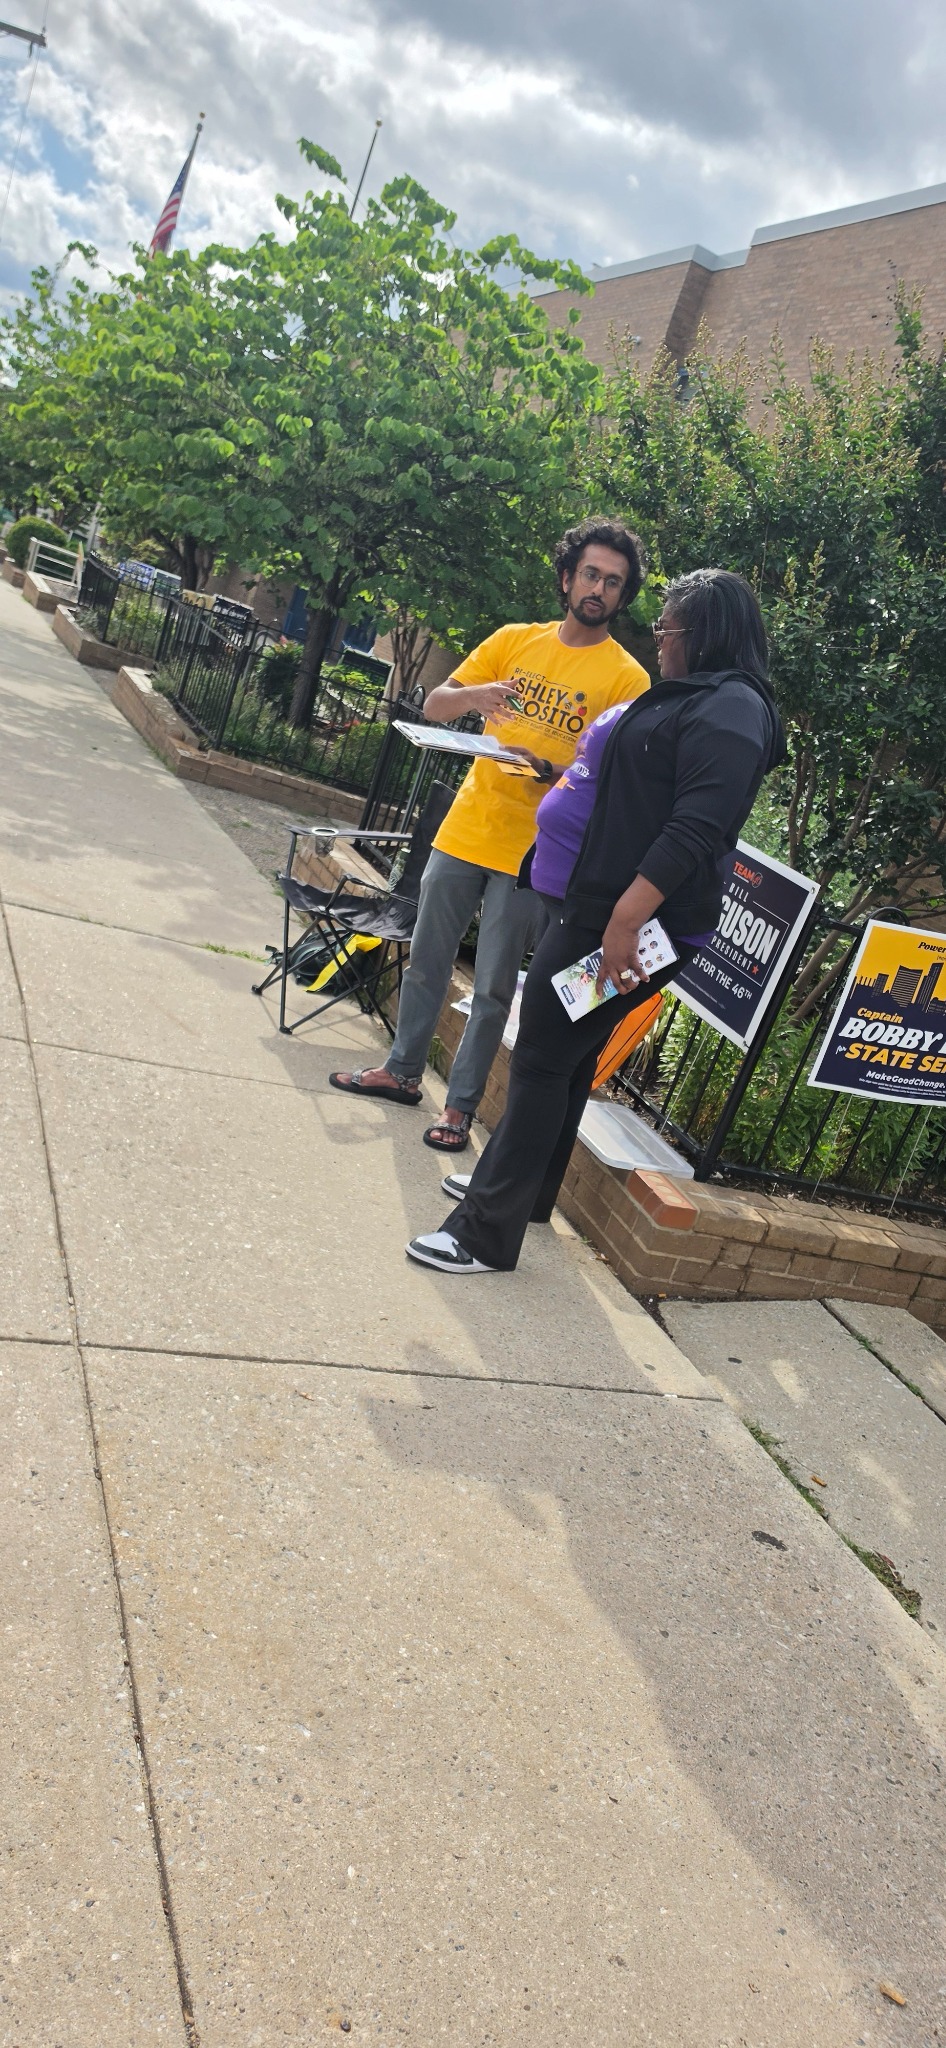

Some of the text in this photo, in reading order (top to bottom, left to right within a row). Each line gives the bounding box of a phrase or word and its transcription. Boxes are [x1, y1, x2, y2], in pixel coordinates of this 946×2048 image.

[514, 667, 547, 682] RE-ELECT
[510, 675, 569, 707] SHLEY
[521, 696, 584, 734] OSITO
[733, 861, 755, 881] TEAM
[728, 882, 749, 903] BILL
[710, 935, 753, 971] PRESIDENT
[698, 957, 717, 978] FOR
[715, 969, 733, 990] THE
[731, 983, 753, 1000] 46TH
[857, 1007, 904, 1024] Captain
[838, 1017, 944, 1052] BOBBY
[844, 1042, 918, 1070] STATE
